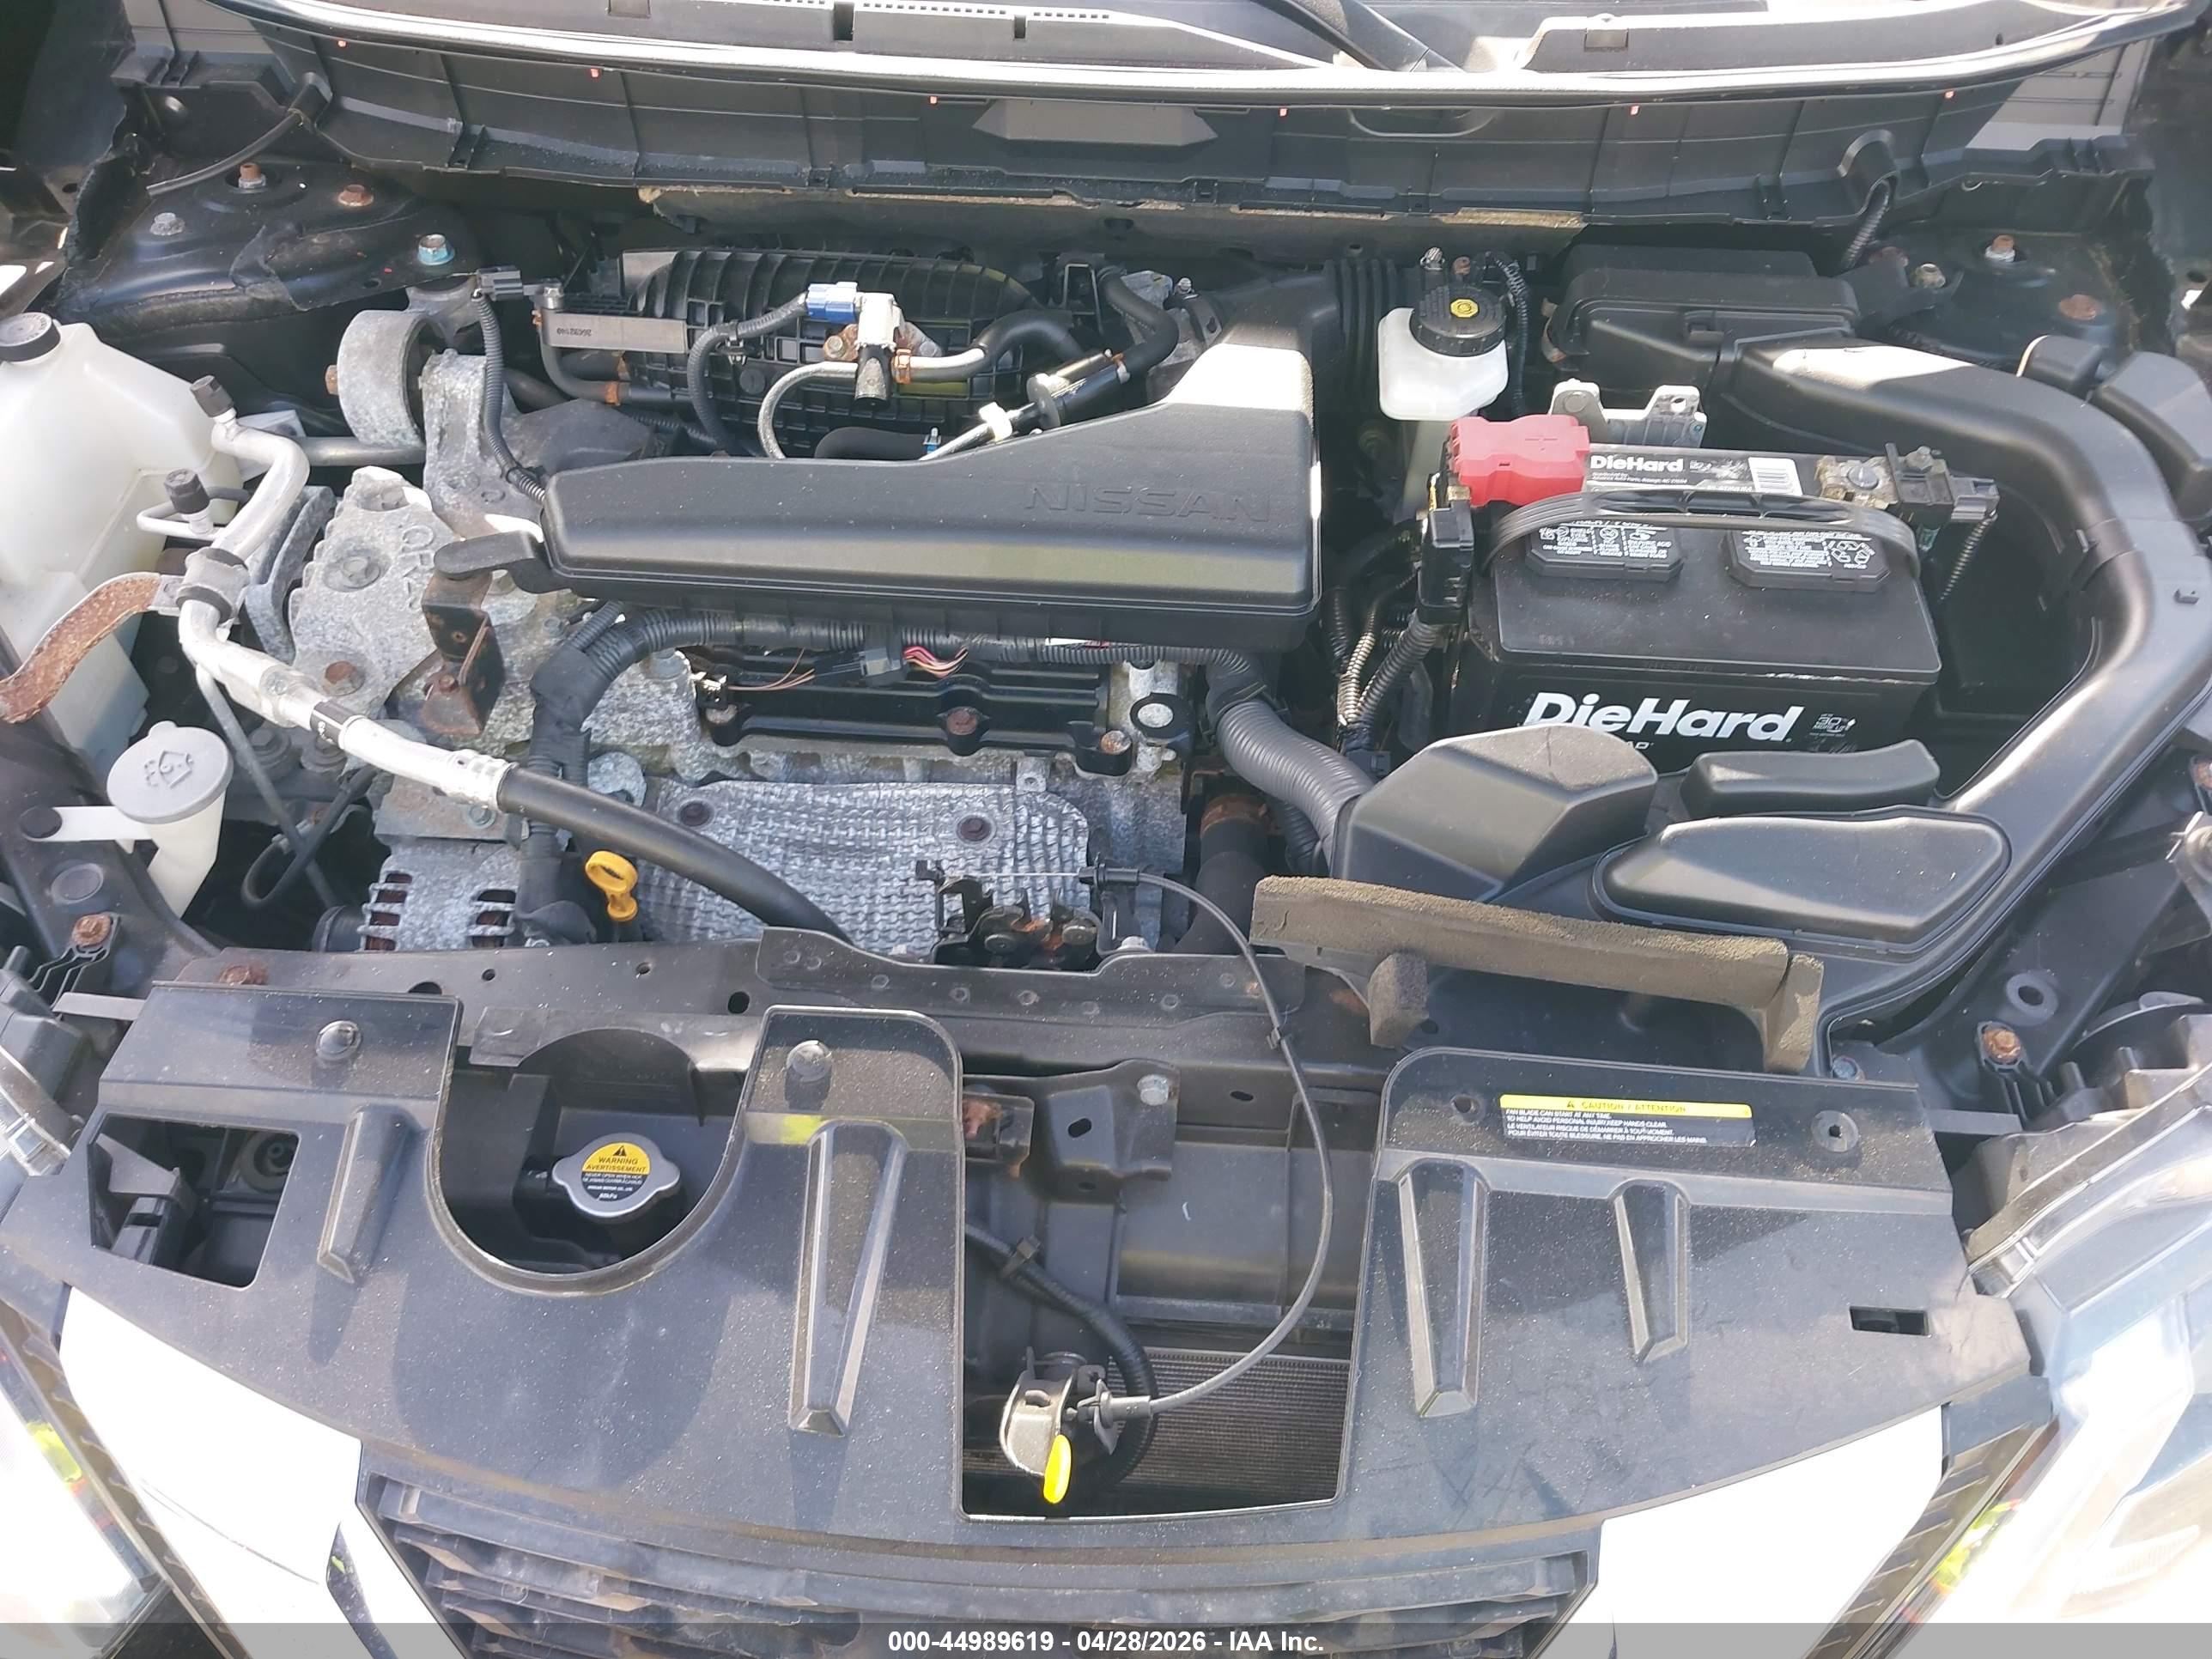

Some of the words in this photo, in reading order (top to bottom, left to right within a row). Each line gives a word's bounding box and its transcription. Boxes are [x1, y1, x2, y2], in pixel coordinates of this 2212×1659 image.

[1590, 454, 1684, 472] DieHard
[1024, 481, 1270, 522] NISSAN
[1523, 692, 1805, 742] DieHard
[1582, 1102, 1624, 1110] CAUTION
[1635, 1103, 1686, 1113] ATTENTION
[586, 1164, 647, 1173] AVERTISSEMENT
